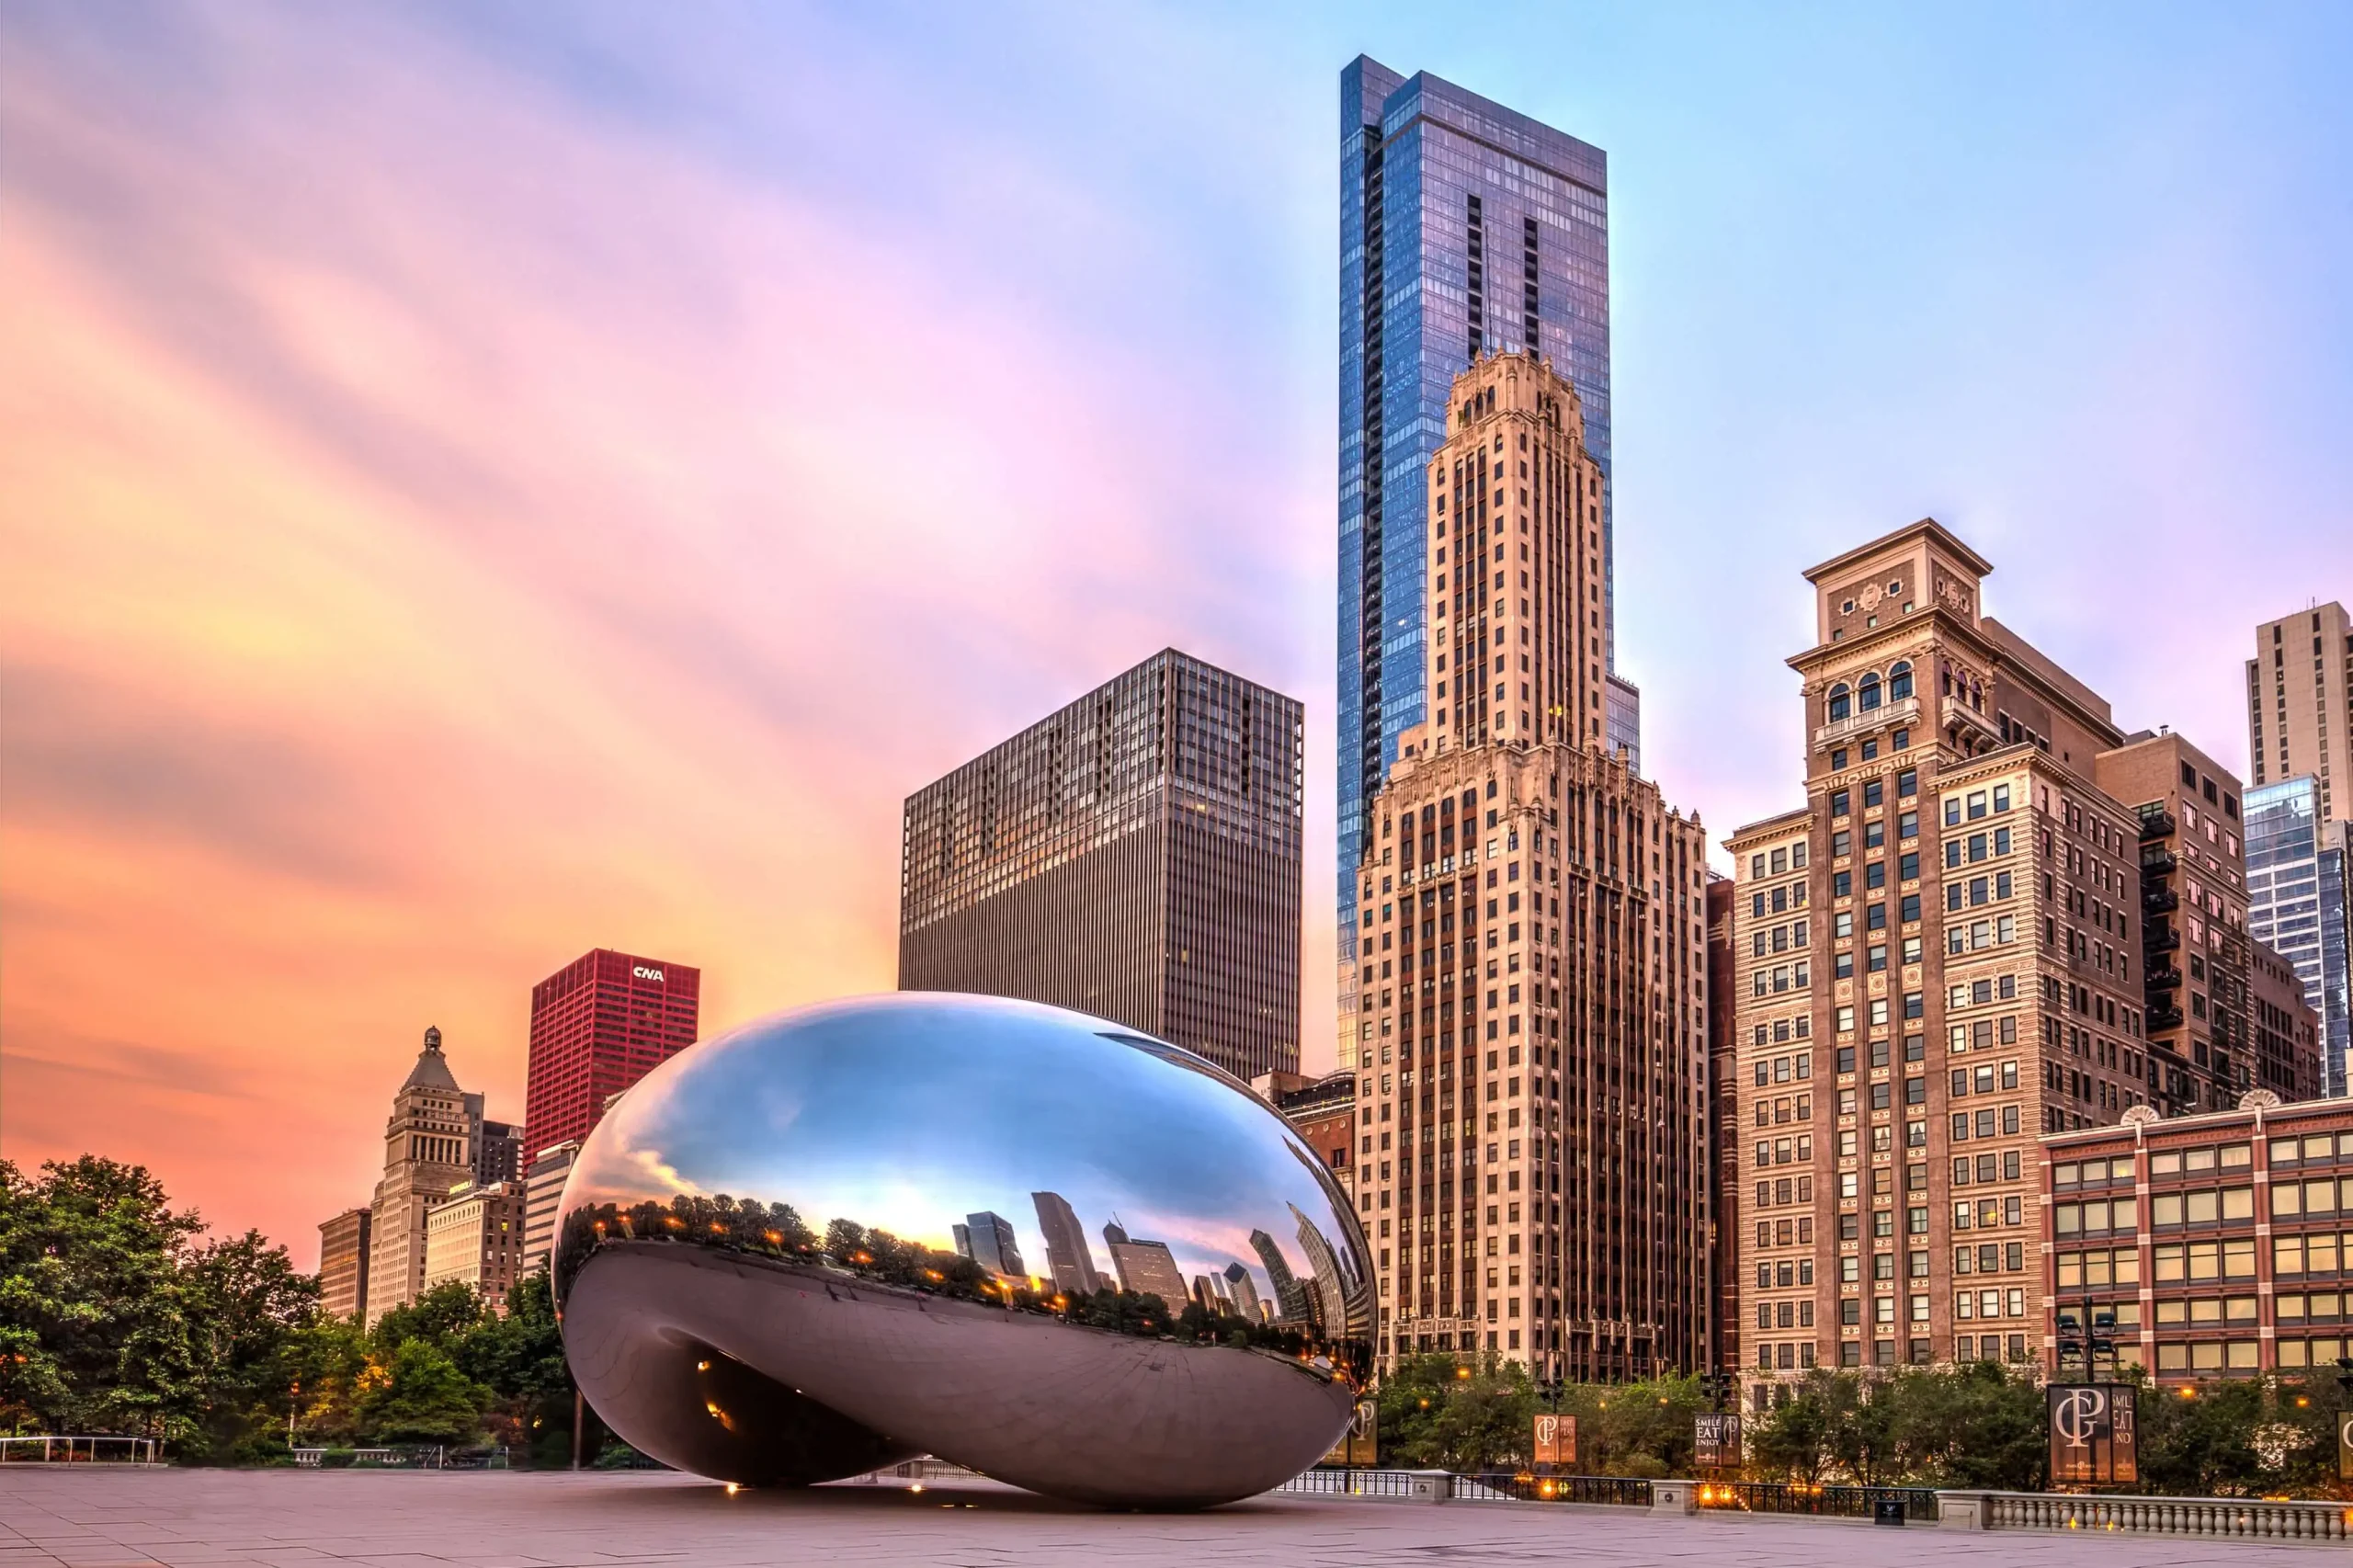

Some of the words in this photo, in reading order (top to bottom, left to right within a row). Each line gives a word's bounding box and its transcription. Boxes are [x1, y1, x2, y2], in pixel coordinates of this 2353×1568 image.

[633, 966, 665, 983] CNA
[1696, 1418, 1721, 1426] SMILE
[2113, 1409, 2133, 1430] EAT
[1696, 1426, 1721, 1438] EAT
[1696, 1438, 1721, 1447] ENJOY
